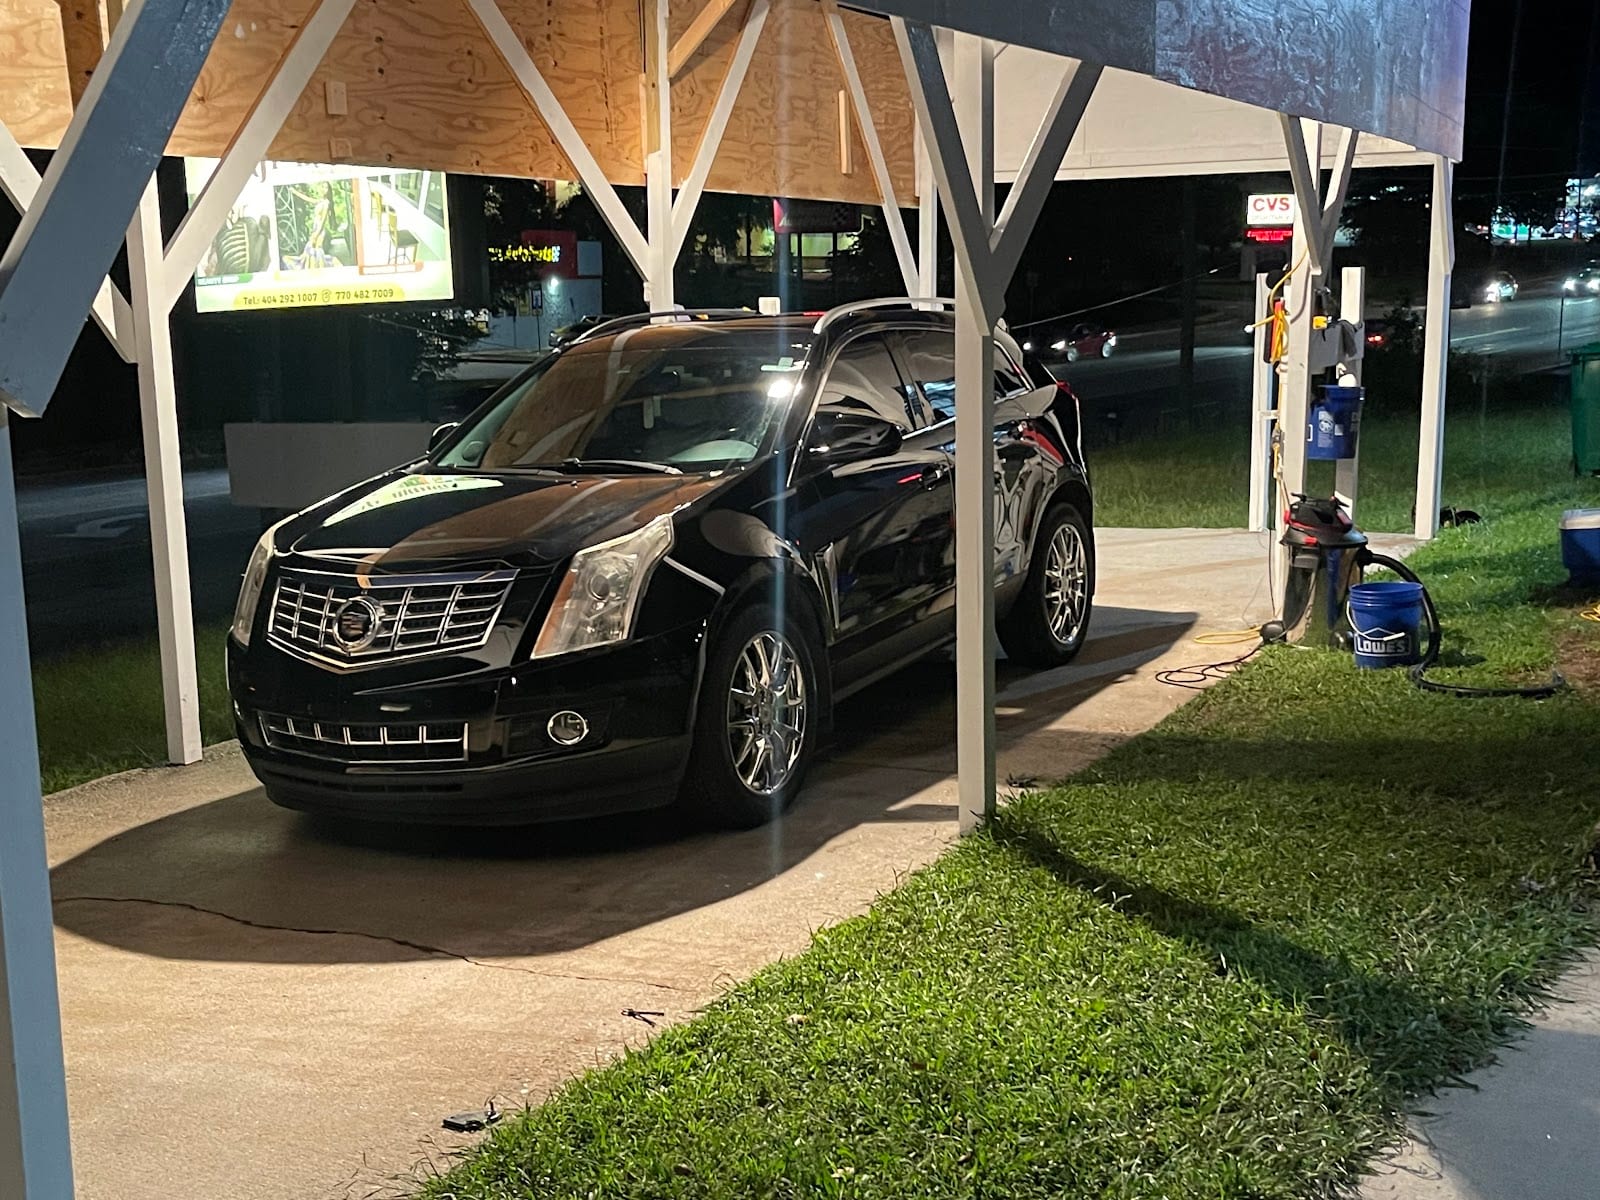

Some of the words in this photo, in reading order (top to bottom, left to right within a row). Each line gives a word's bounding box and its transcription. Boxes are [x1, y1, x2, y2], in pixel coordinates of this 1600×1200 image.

[1253, 197, 1290, 212] CVS
[262, 295, 277, 304] 404
[280, 294, 295, 303] 292
[298, 293, 317, 302] 1007
[336, 291, 351, 300] 770
[354, 290, 369, 299] 482
[373, 289, 394, 298] 7009
